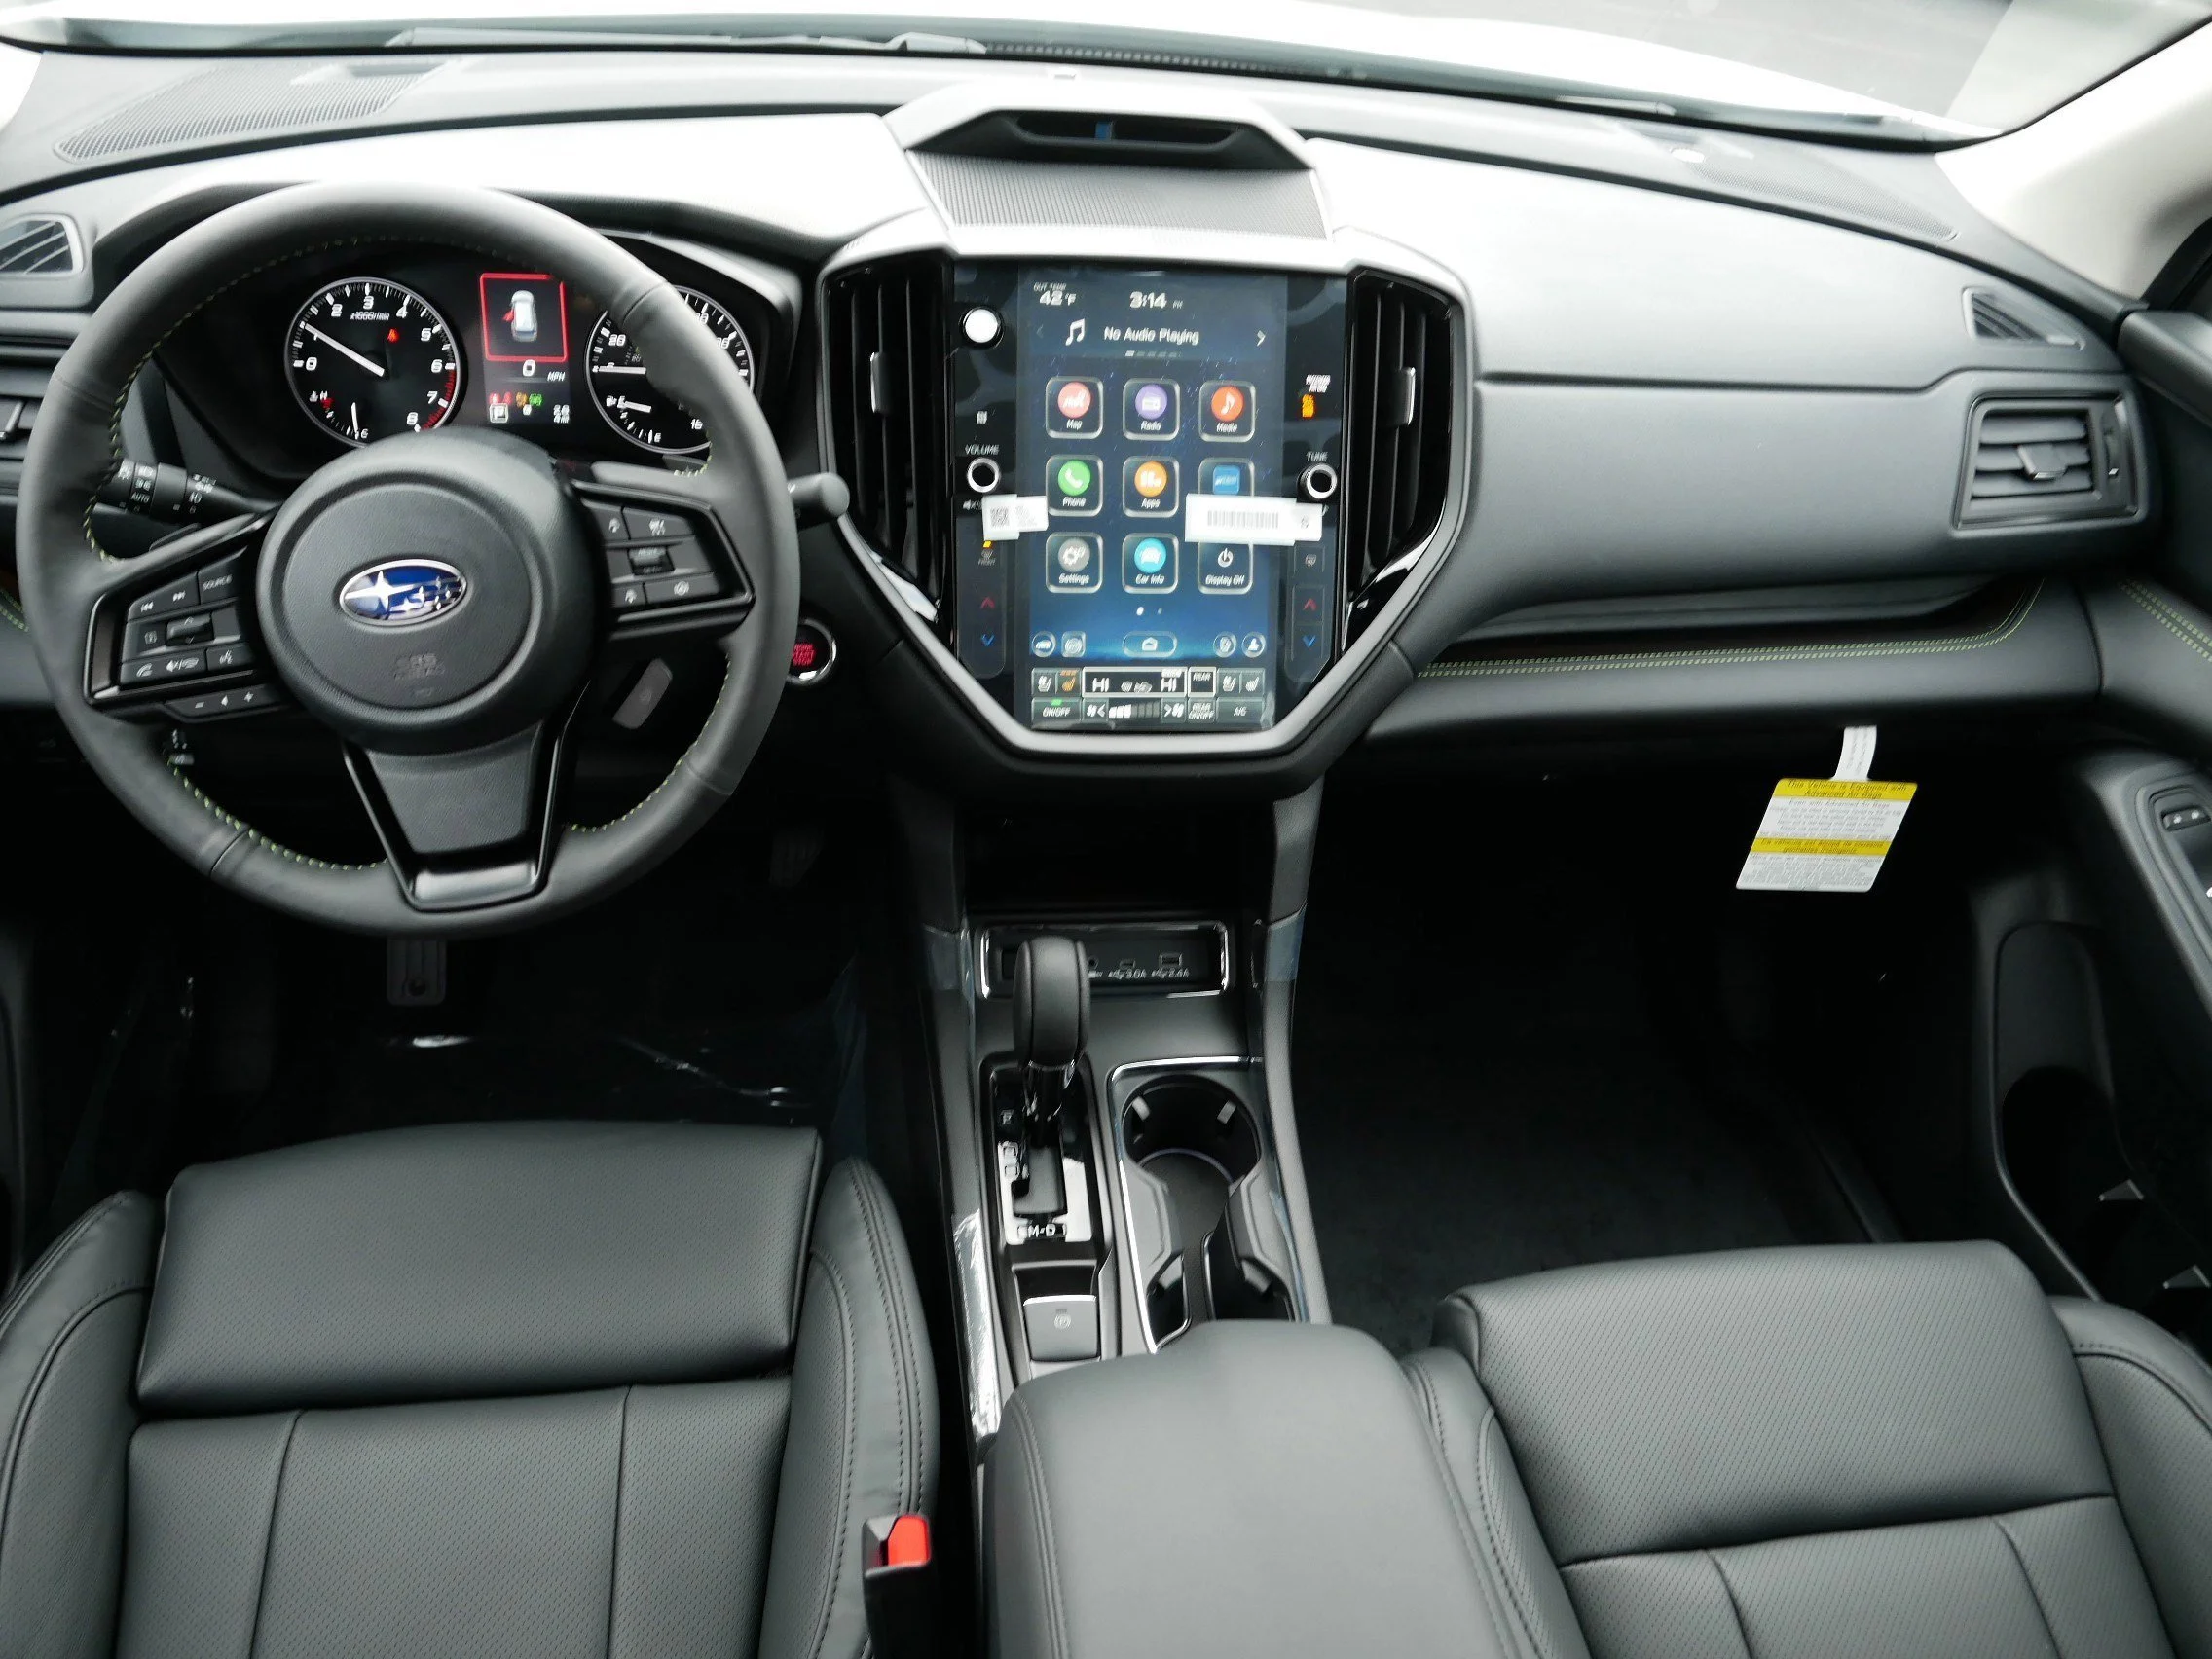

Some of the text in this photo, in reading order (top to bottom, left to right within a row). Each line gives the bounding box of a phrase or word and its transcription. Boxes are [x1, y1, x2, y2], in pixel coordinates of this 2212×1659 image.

[363, 295, 374, 310] 3
[1039, 291, 1063, 306] 42
[331, 303, 343, 317] 2
[396, 306, 408, 318] 4
[421, 328, 432, 342] 5
[1104, 326, 1200, 346] No Audio Playing
[305, 356, 317, 371] 0
[431, 359, 442, 373] 6
[1066, 419, 1083, 430] Map
[1062, 496, 1087, 507] Phone
[1141, 498, 1161, 508] Apps
[1059, 573, 1090, 585] Settings
